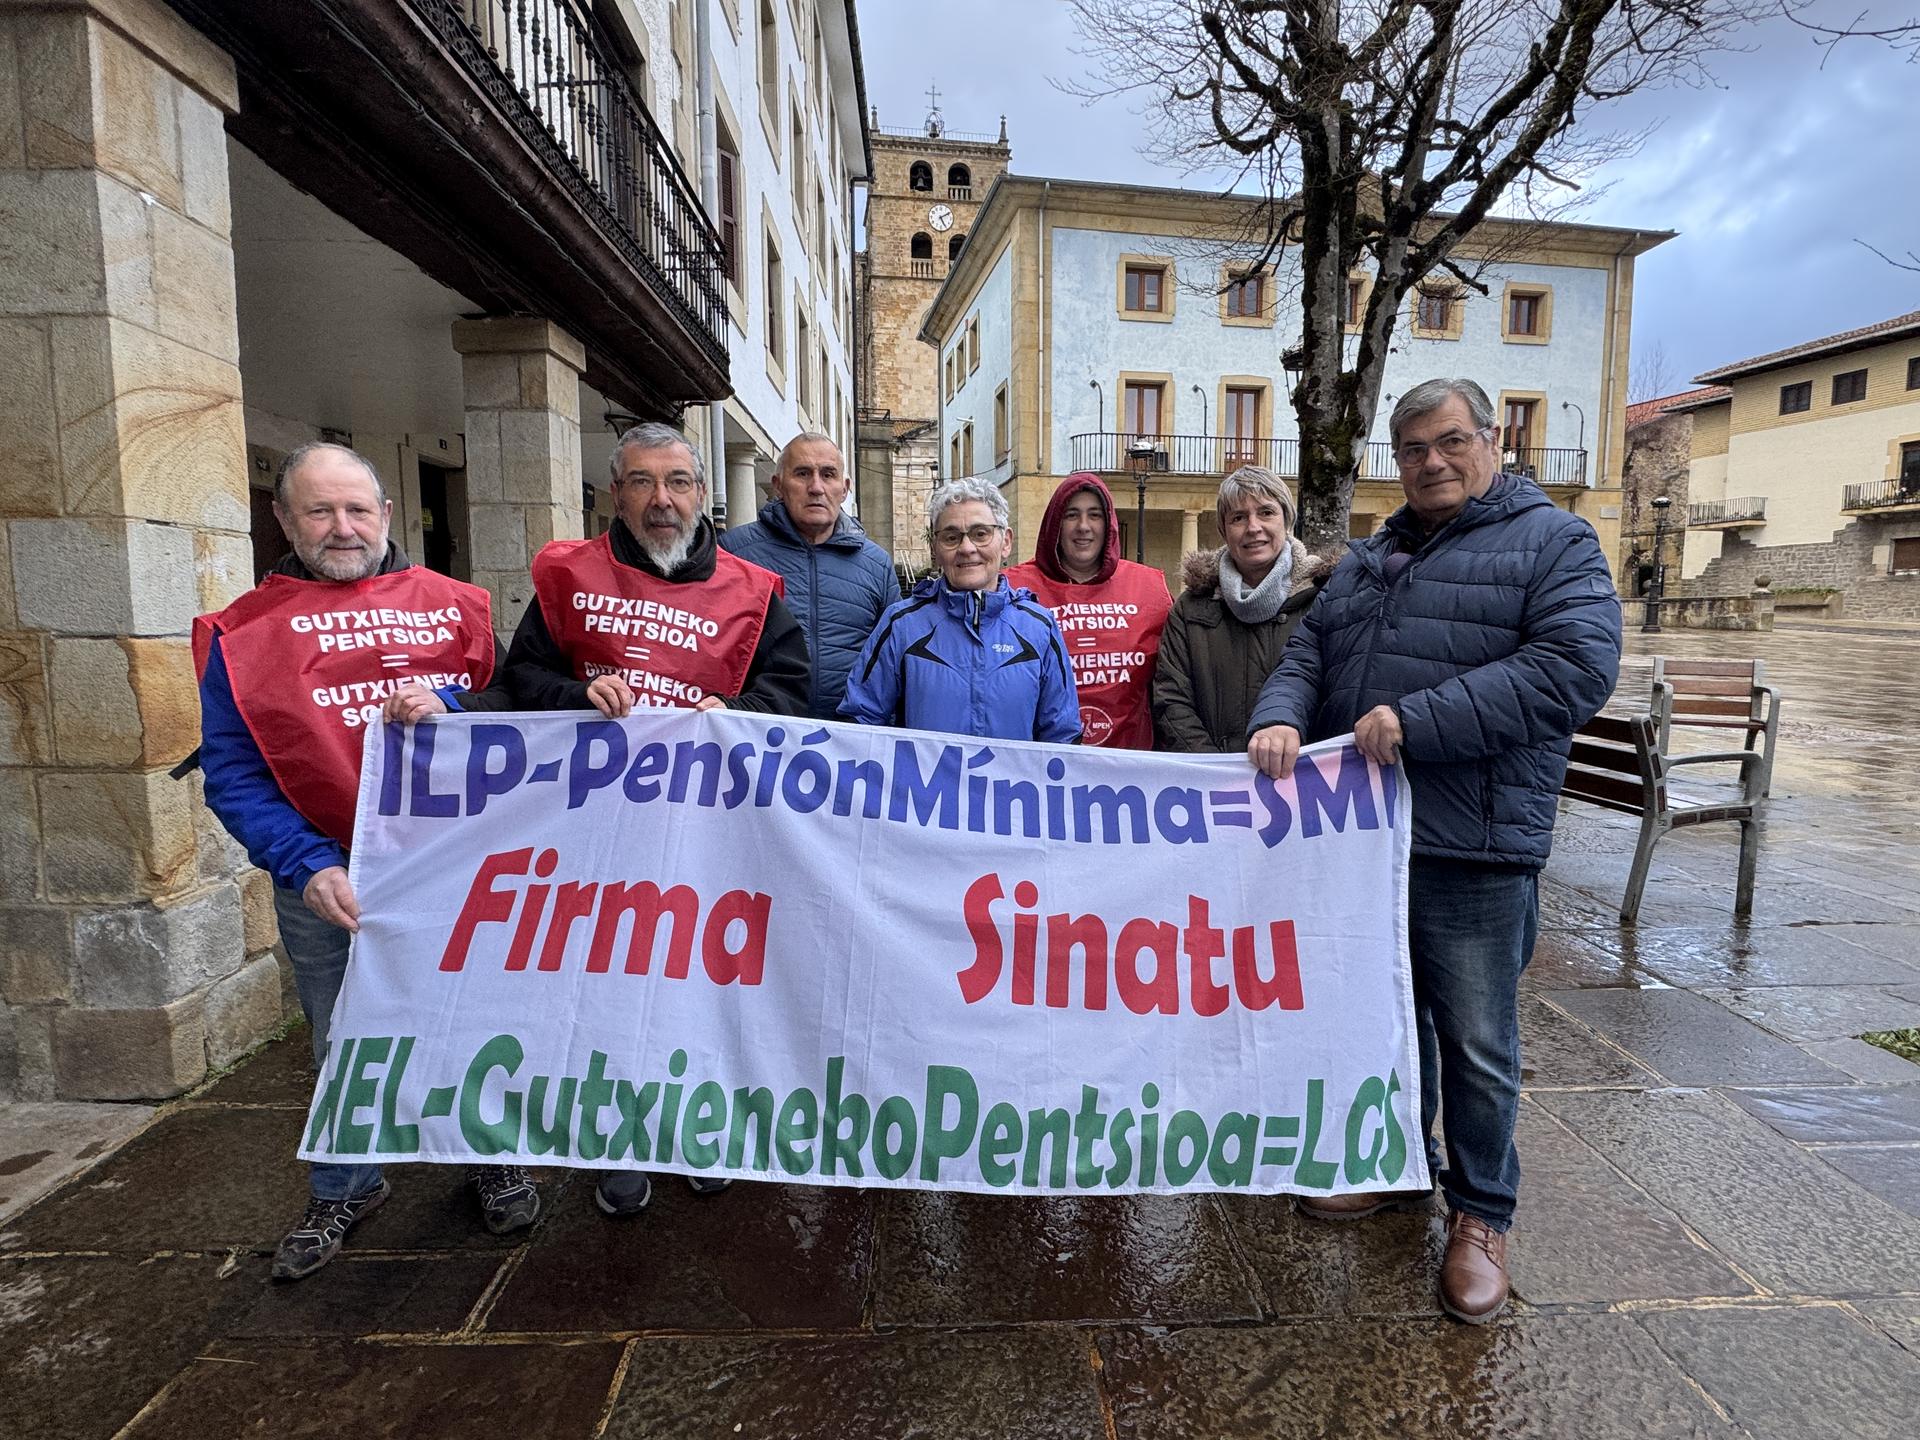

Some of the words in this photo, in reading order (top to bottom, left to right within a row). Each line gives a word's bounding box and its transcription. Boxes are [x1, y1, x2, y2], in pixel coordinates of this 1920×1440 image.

[290, 606, 462, 634] GUTXIENEKO
[572, 591, 719, 638] GUTXIENEKO
[1050, 602, 1139, 618] TXIENEKO
[1057, 615, 1130, 632] NTSIOA
[318, 627, 455, 653] PENTSIOA
[585, 614, 699, 652] PENTSIOA
[1069, 651, 1146, 669] XIENEKO
[1073, 668, 1131, 686] LDATA
[438, 846, 773, 986] Firma
[956, 872, 1305, 1017] Sinatu
